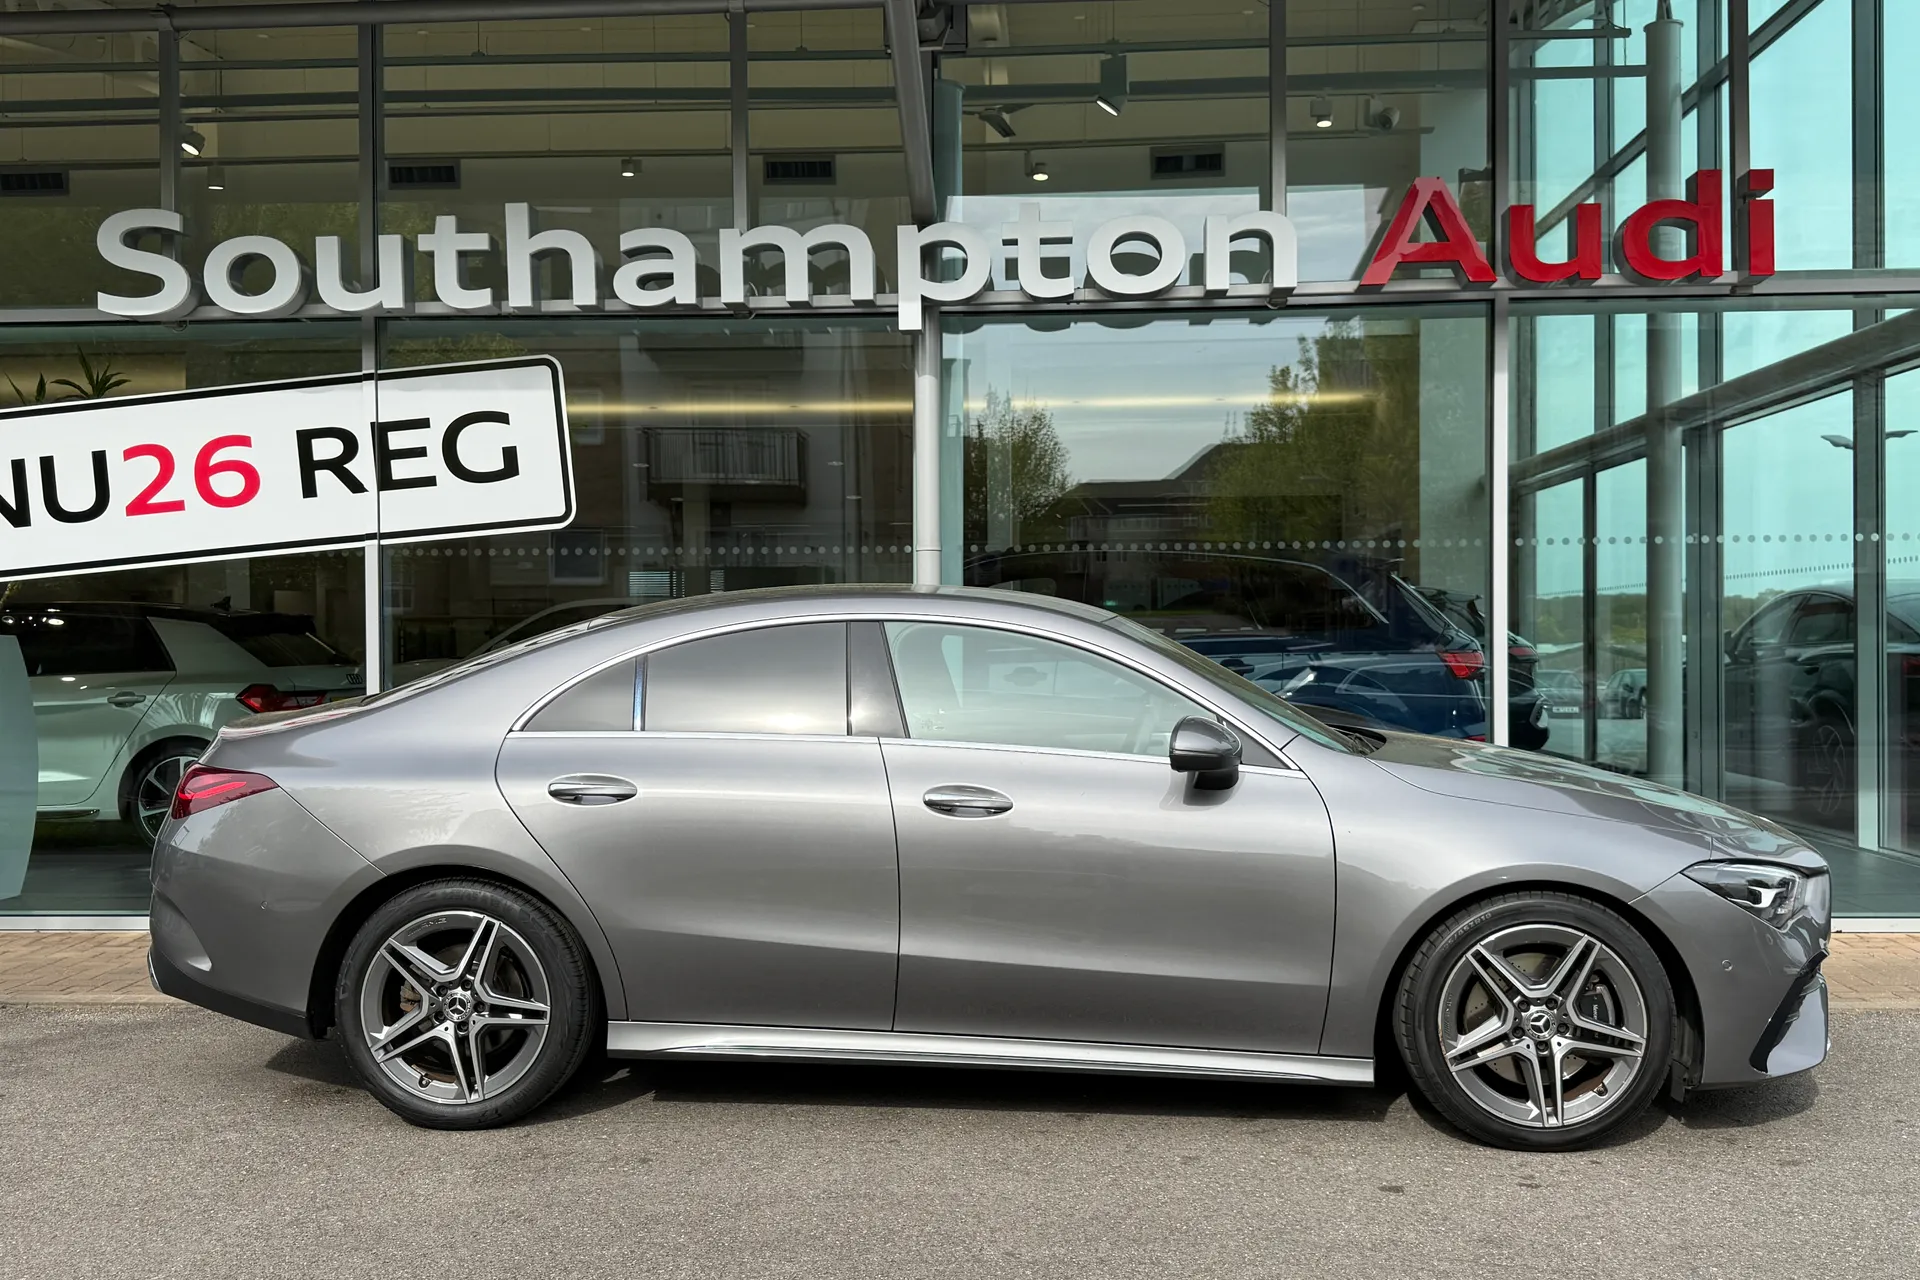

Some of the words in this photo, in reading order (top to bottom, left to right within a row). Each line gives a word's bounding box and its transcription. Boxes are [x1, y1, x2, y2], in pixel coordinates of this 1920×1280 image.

[97, 201, 1297, 331] Southampton
[1357, 169, 1775, 288] Audi
[296, 410, 520, 499] REG
